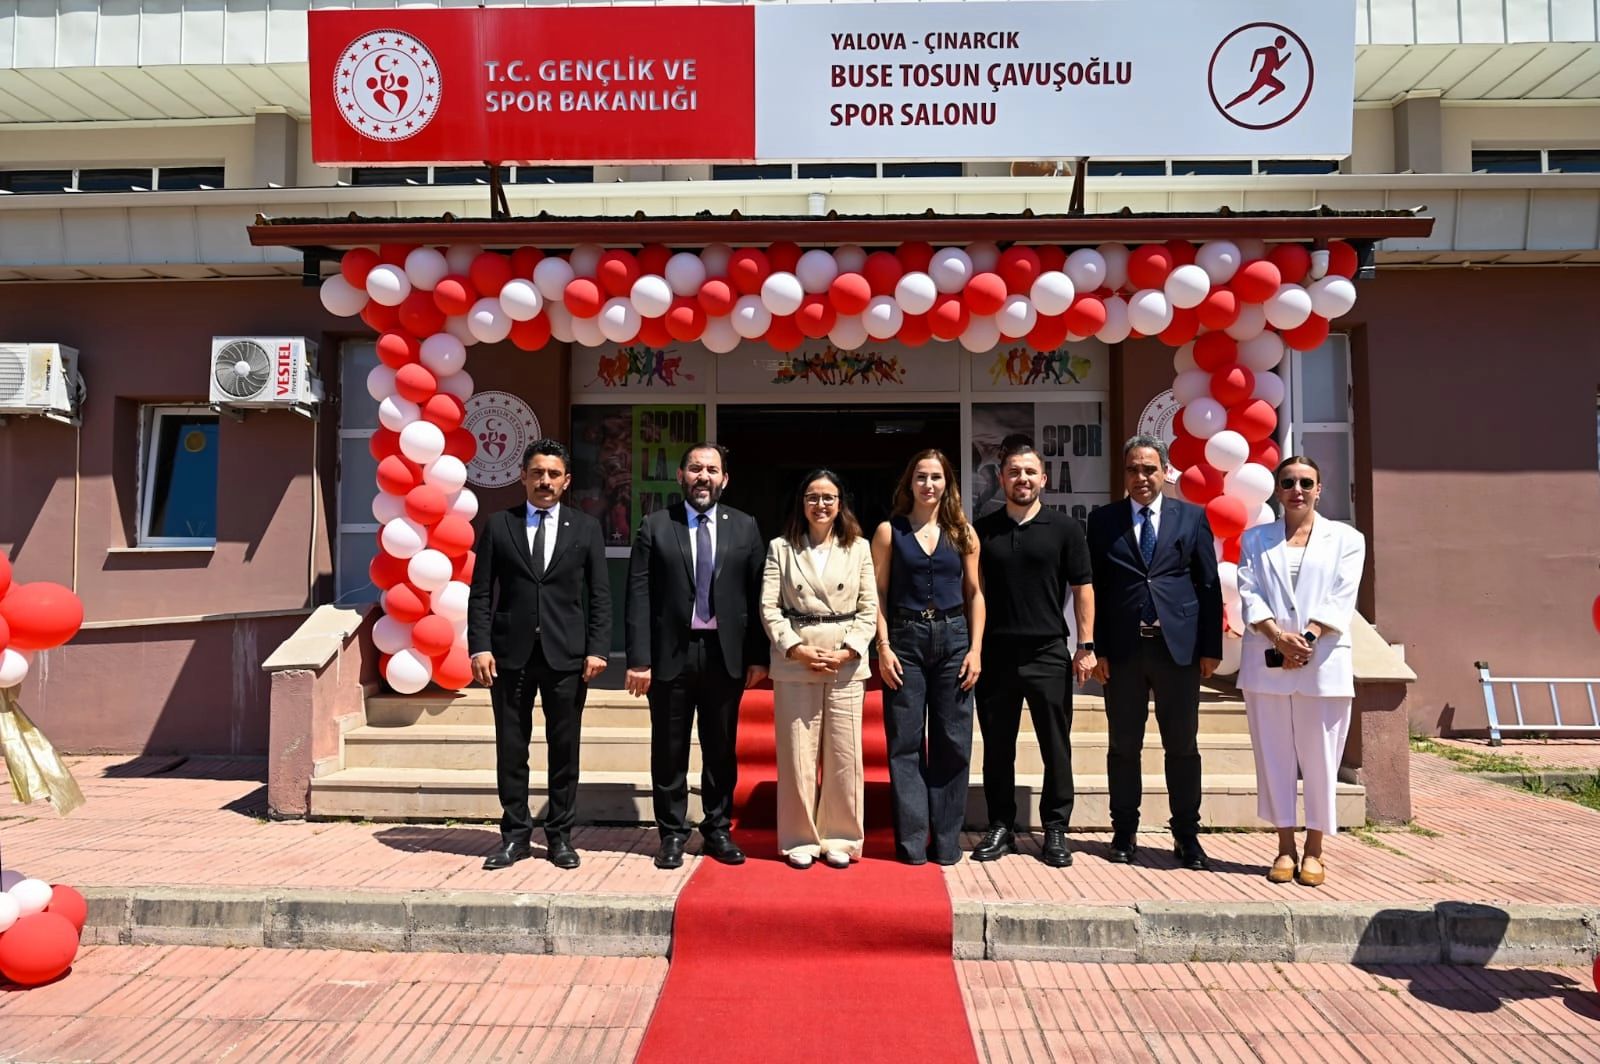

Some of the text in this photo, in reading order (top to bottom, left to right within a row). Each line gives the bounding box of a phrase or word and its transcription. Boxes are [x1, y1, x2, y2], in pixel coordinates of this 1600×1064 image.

[831, 33, 907, 50] YALOVA
[924, 31, 1019, 54] ÇINARCIK
[484, 56, 697, 86] T.C. GENÇLİK VE
[831, 57, 1132, 93] BUSE TOSUN ÇAVUŞOĞLU
[485, 85, 697, 112] SPOR BAKANLIĞI
[830, 102, 996, 127] SPOR SALONU
[276, 342, 291, 396] VESTEL
[640, 410, 699, 443] SPOR
[1042, 424, 1103, 457] SPOR
[641, 447, 669, 481] LA
[1045, 461, 1073, 494] LA
